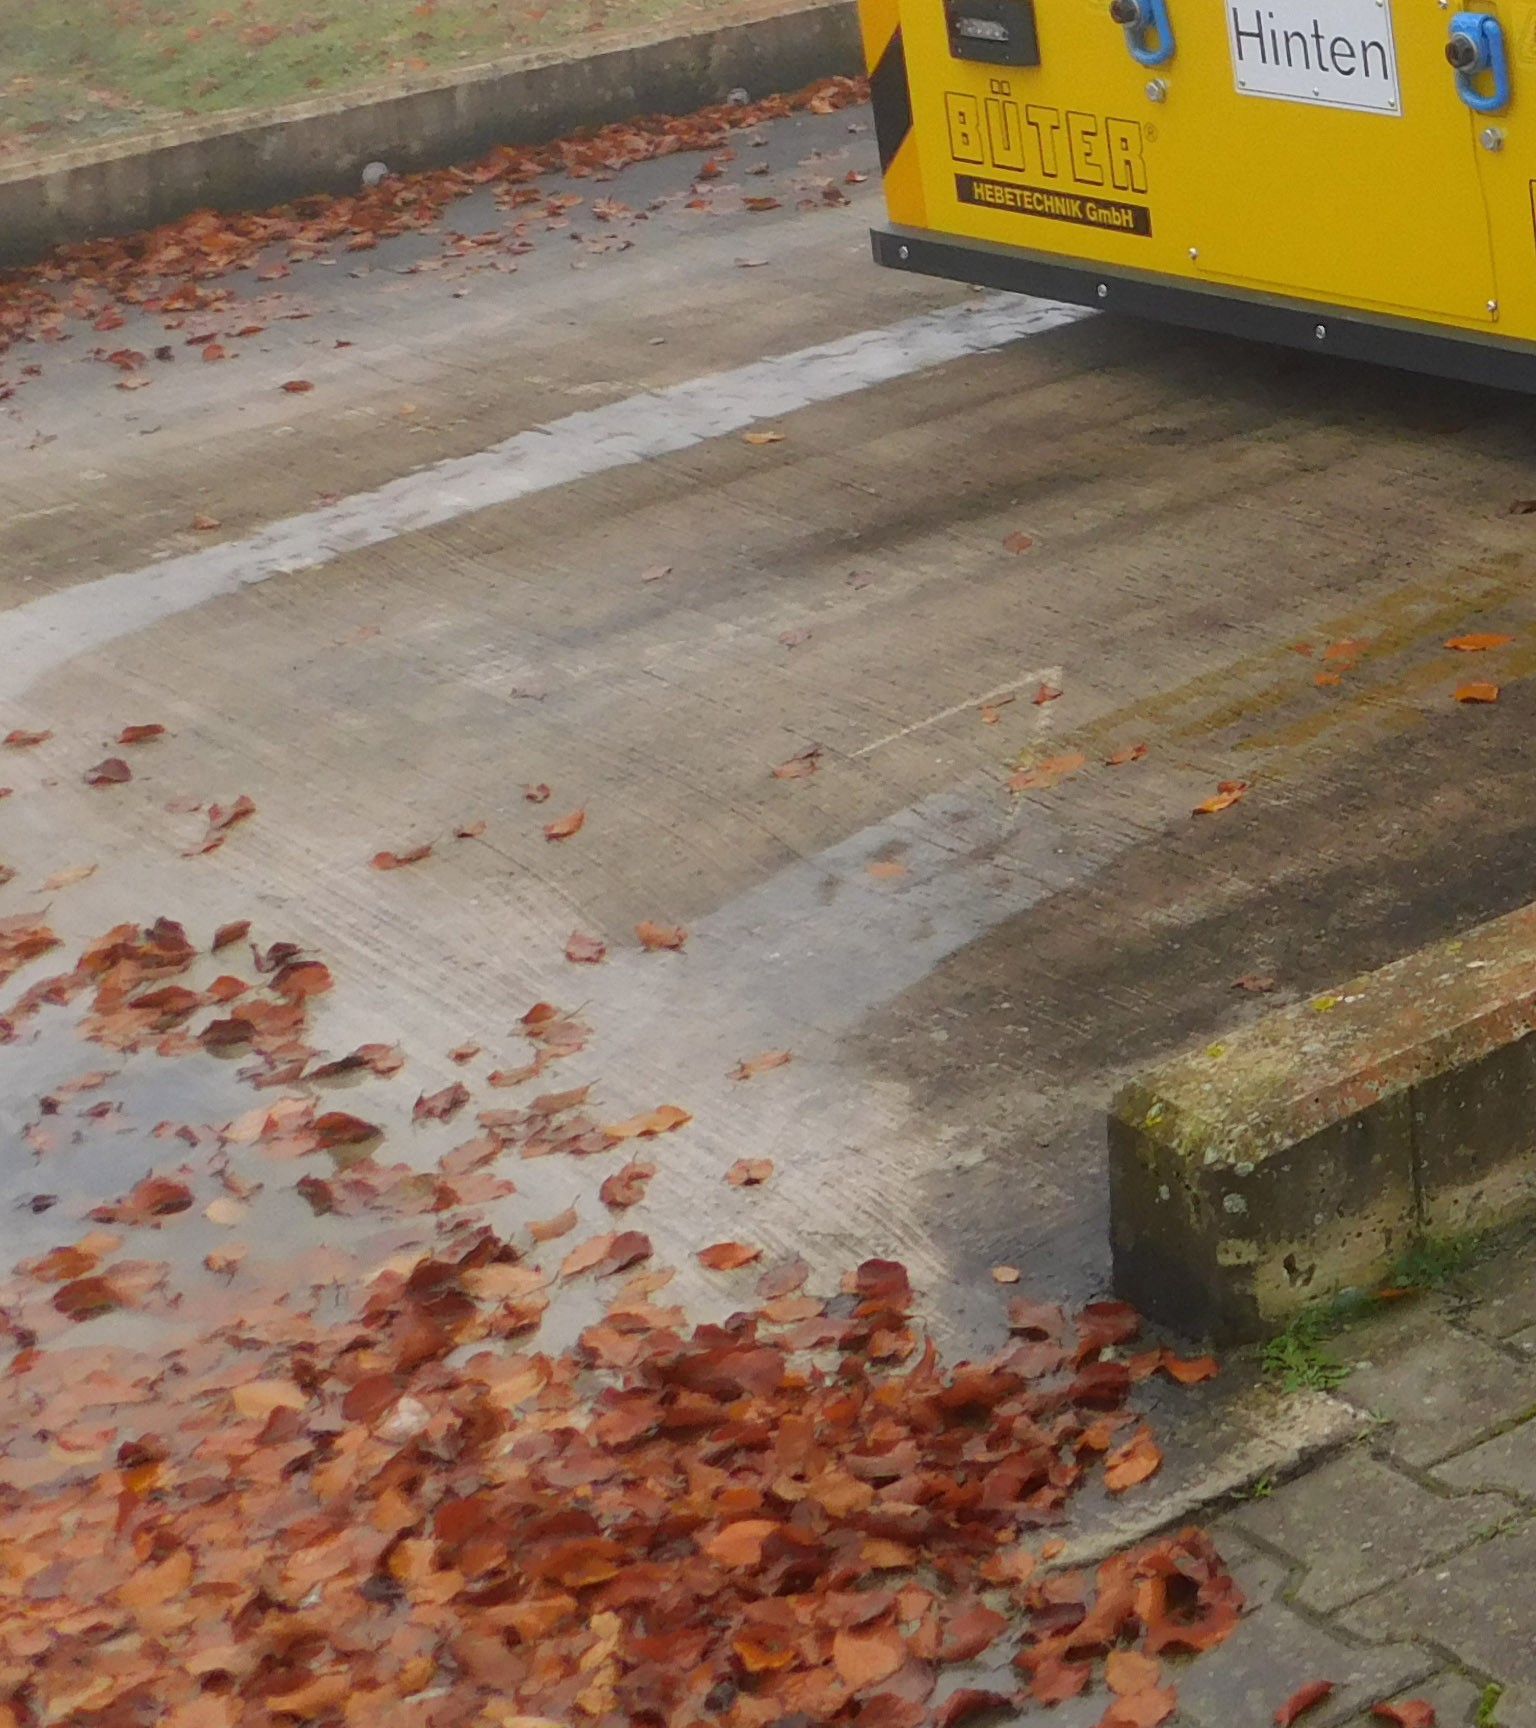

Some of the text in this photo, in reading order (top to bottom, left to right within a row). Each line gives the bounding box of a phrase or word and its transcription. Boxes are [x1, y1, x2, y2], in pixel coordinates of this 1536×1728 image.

[1231, 6, 1389, 80] Hinten
[972, 181, 1134, 228] HEBETECHNIK GmbH
